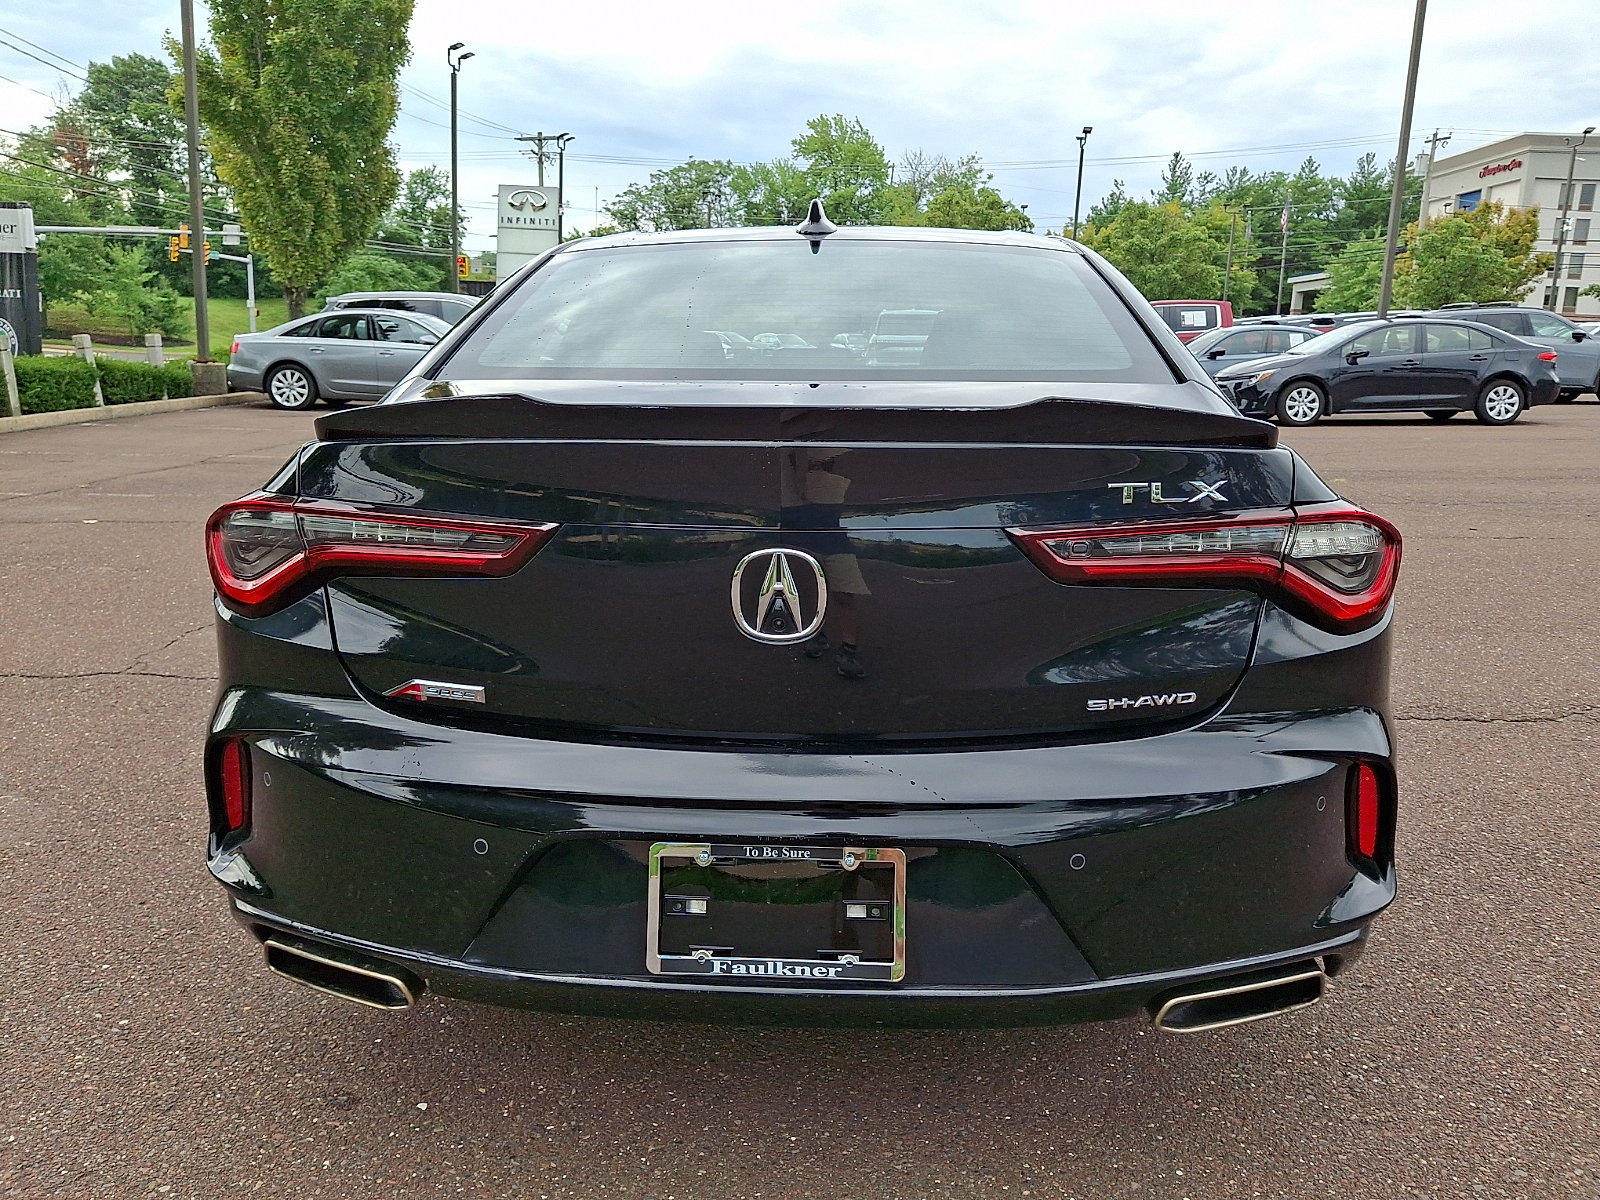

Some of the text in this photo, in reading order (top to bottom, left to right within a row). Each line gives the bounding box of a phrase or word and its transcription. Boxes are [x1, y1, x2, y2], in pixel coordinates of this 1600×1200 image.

[500, 216, 556, 226] INFINITI
[1107, 480, 1229, 505] TLX
[743, 846, 811, 859] To Be Sure
[710, 960, 843, 978] Faulkner
